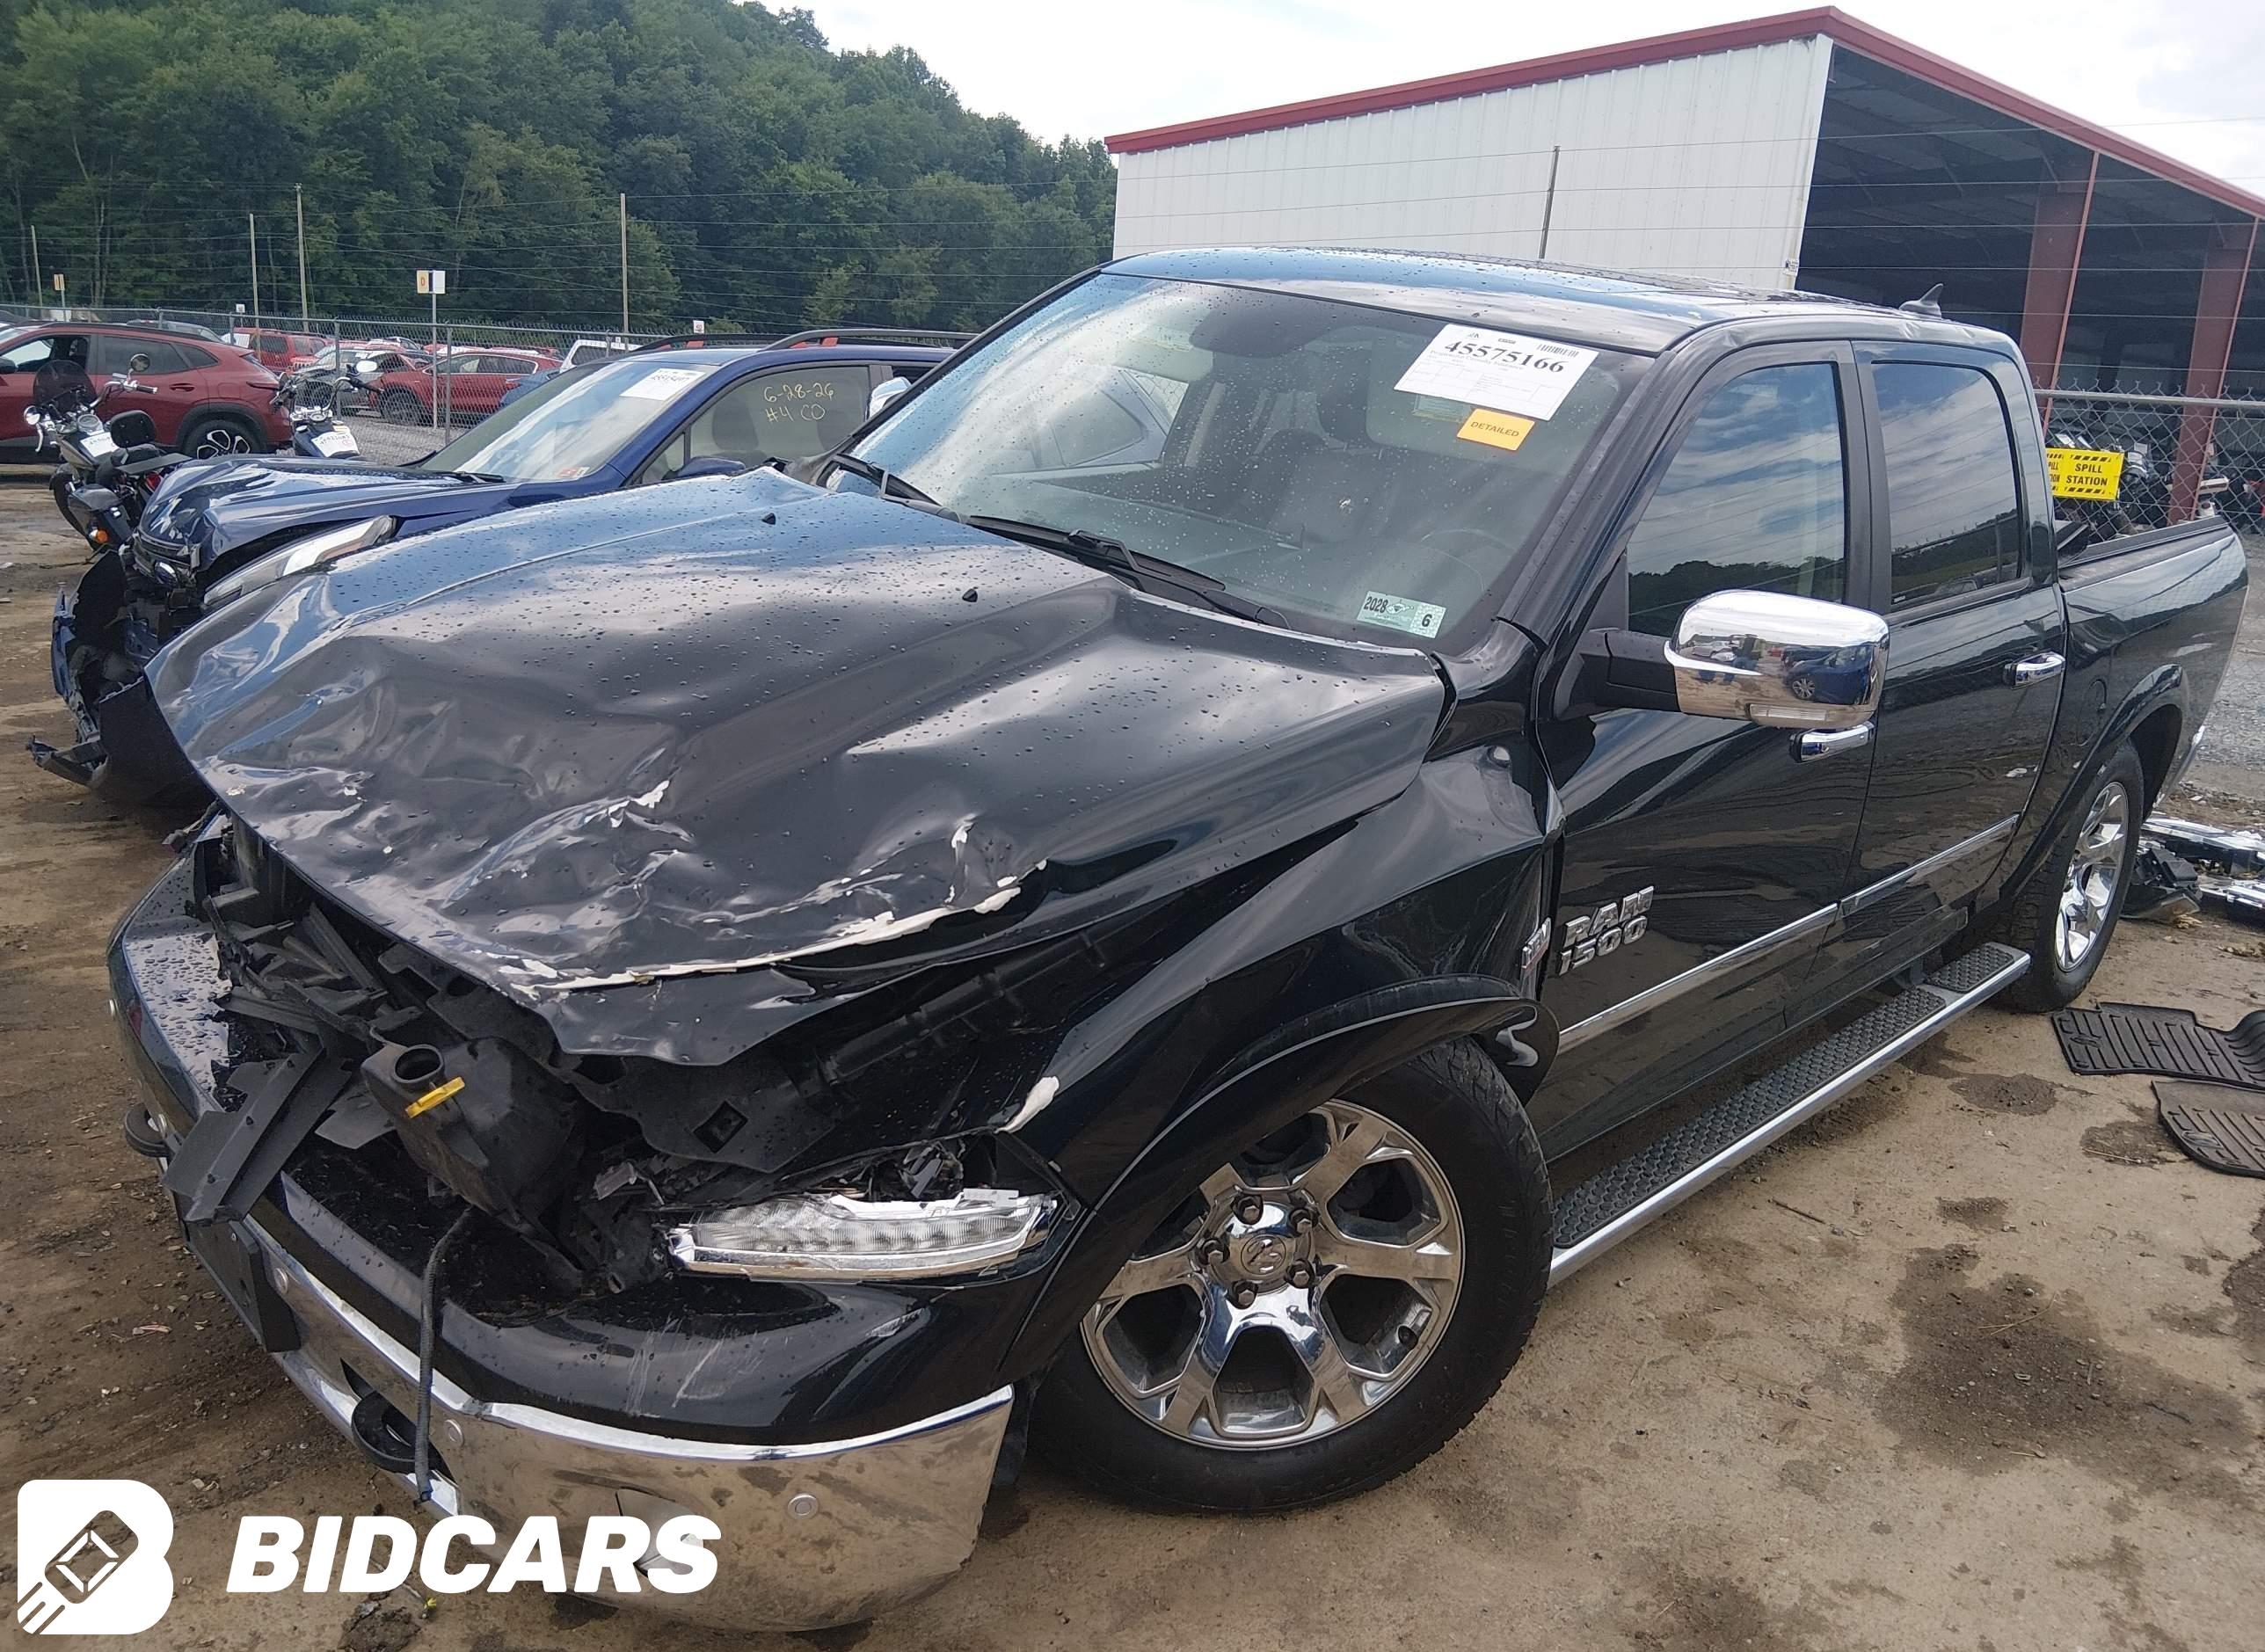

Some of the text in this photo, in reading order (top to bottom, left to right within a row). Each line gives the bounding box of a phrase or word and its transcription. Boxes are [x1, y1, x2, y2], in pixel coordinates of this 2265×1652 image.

[1445, 340, 1568, 373] 45575166
[763, 382, 834, 403] 6-28-26
[1470, 421, 1519, 437] DETAILED
[2075, 463, 2102, 473] SPILL
[2066, 475, 2108, 485] STATION
[1363, 596, 1389, 614] 2028
[1421, 613, 1433, 628] 6
[1562, 884, 1655, 949] RAM
[1556, 914, 1648, 977] 1500
